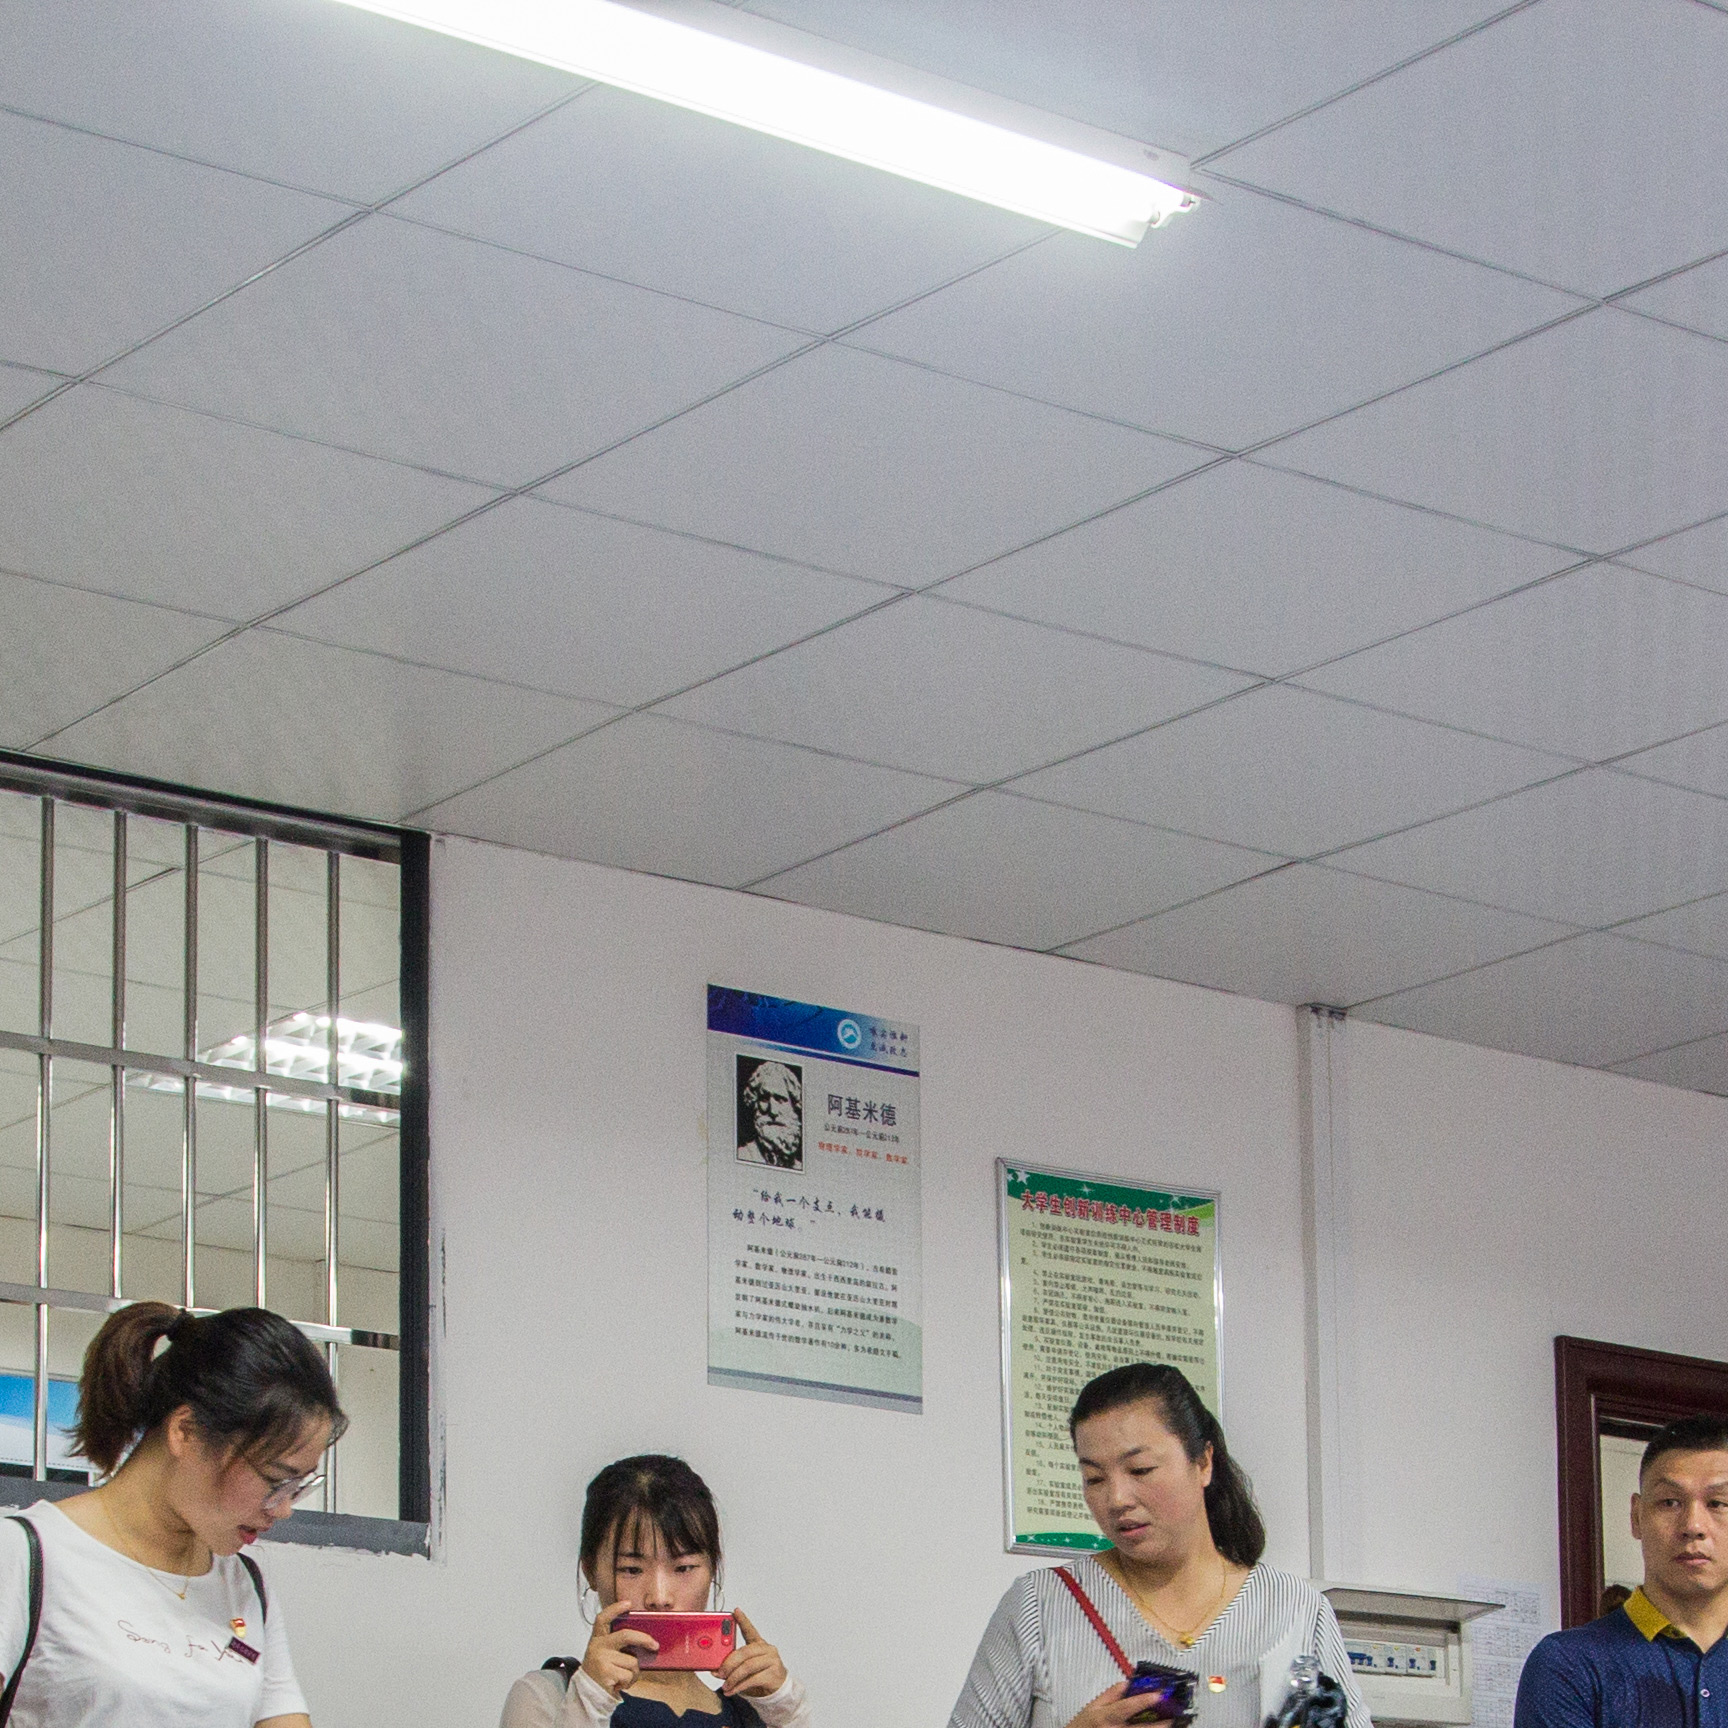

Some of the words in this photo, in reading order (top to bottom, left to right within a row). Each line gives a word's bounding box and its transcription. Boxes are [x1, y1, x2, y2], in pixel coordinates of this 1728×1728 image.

[827, 1093, 897, 1128] 阿基米德
[1020, 1188, 1201, 1237] 大学生创新训练中心管理制度
